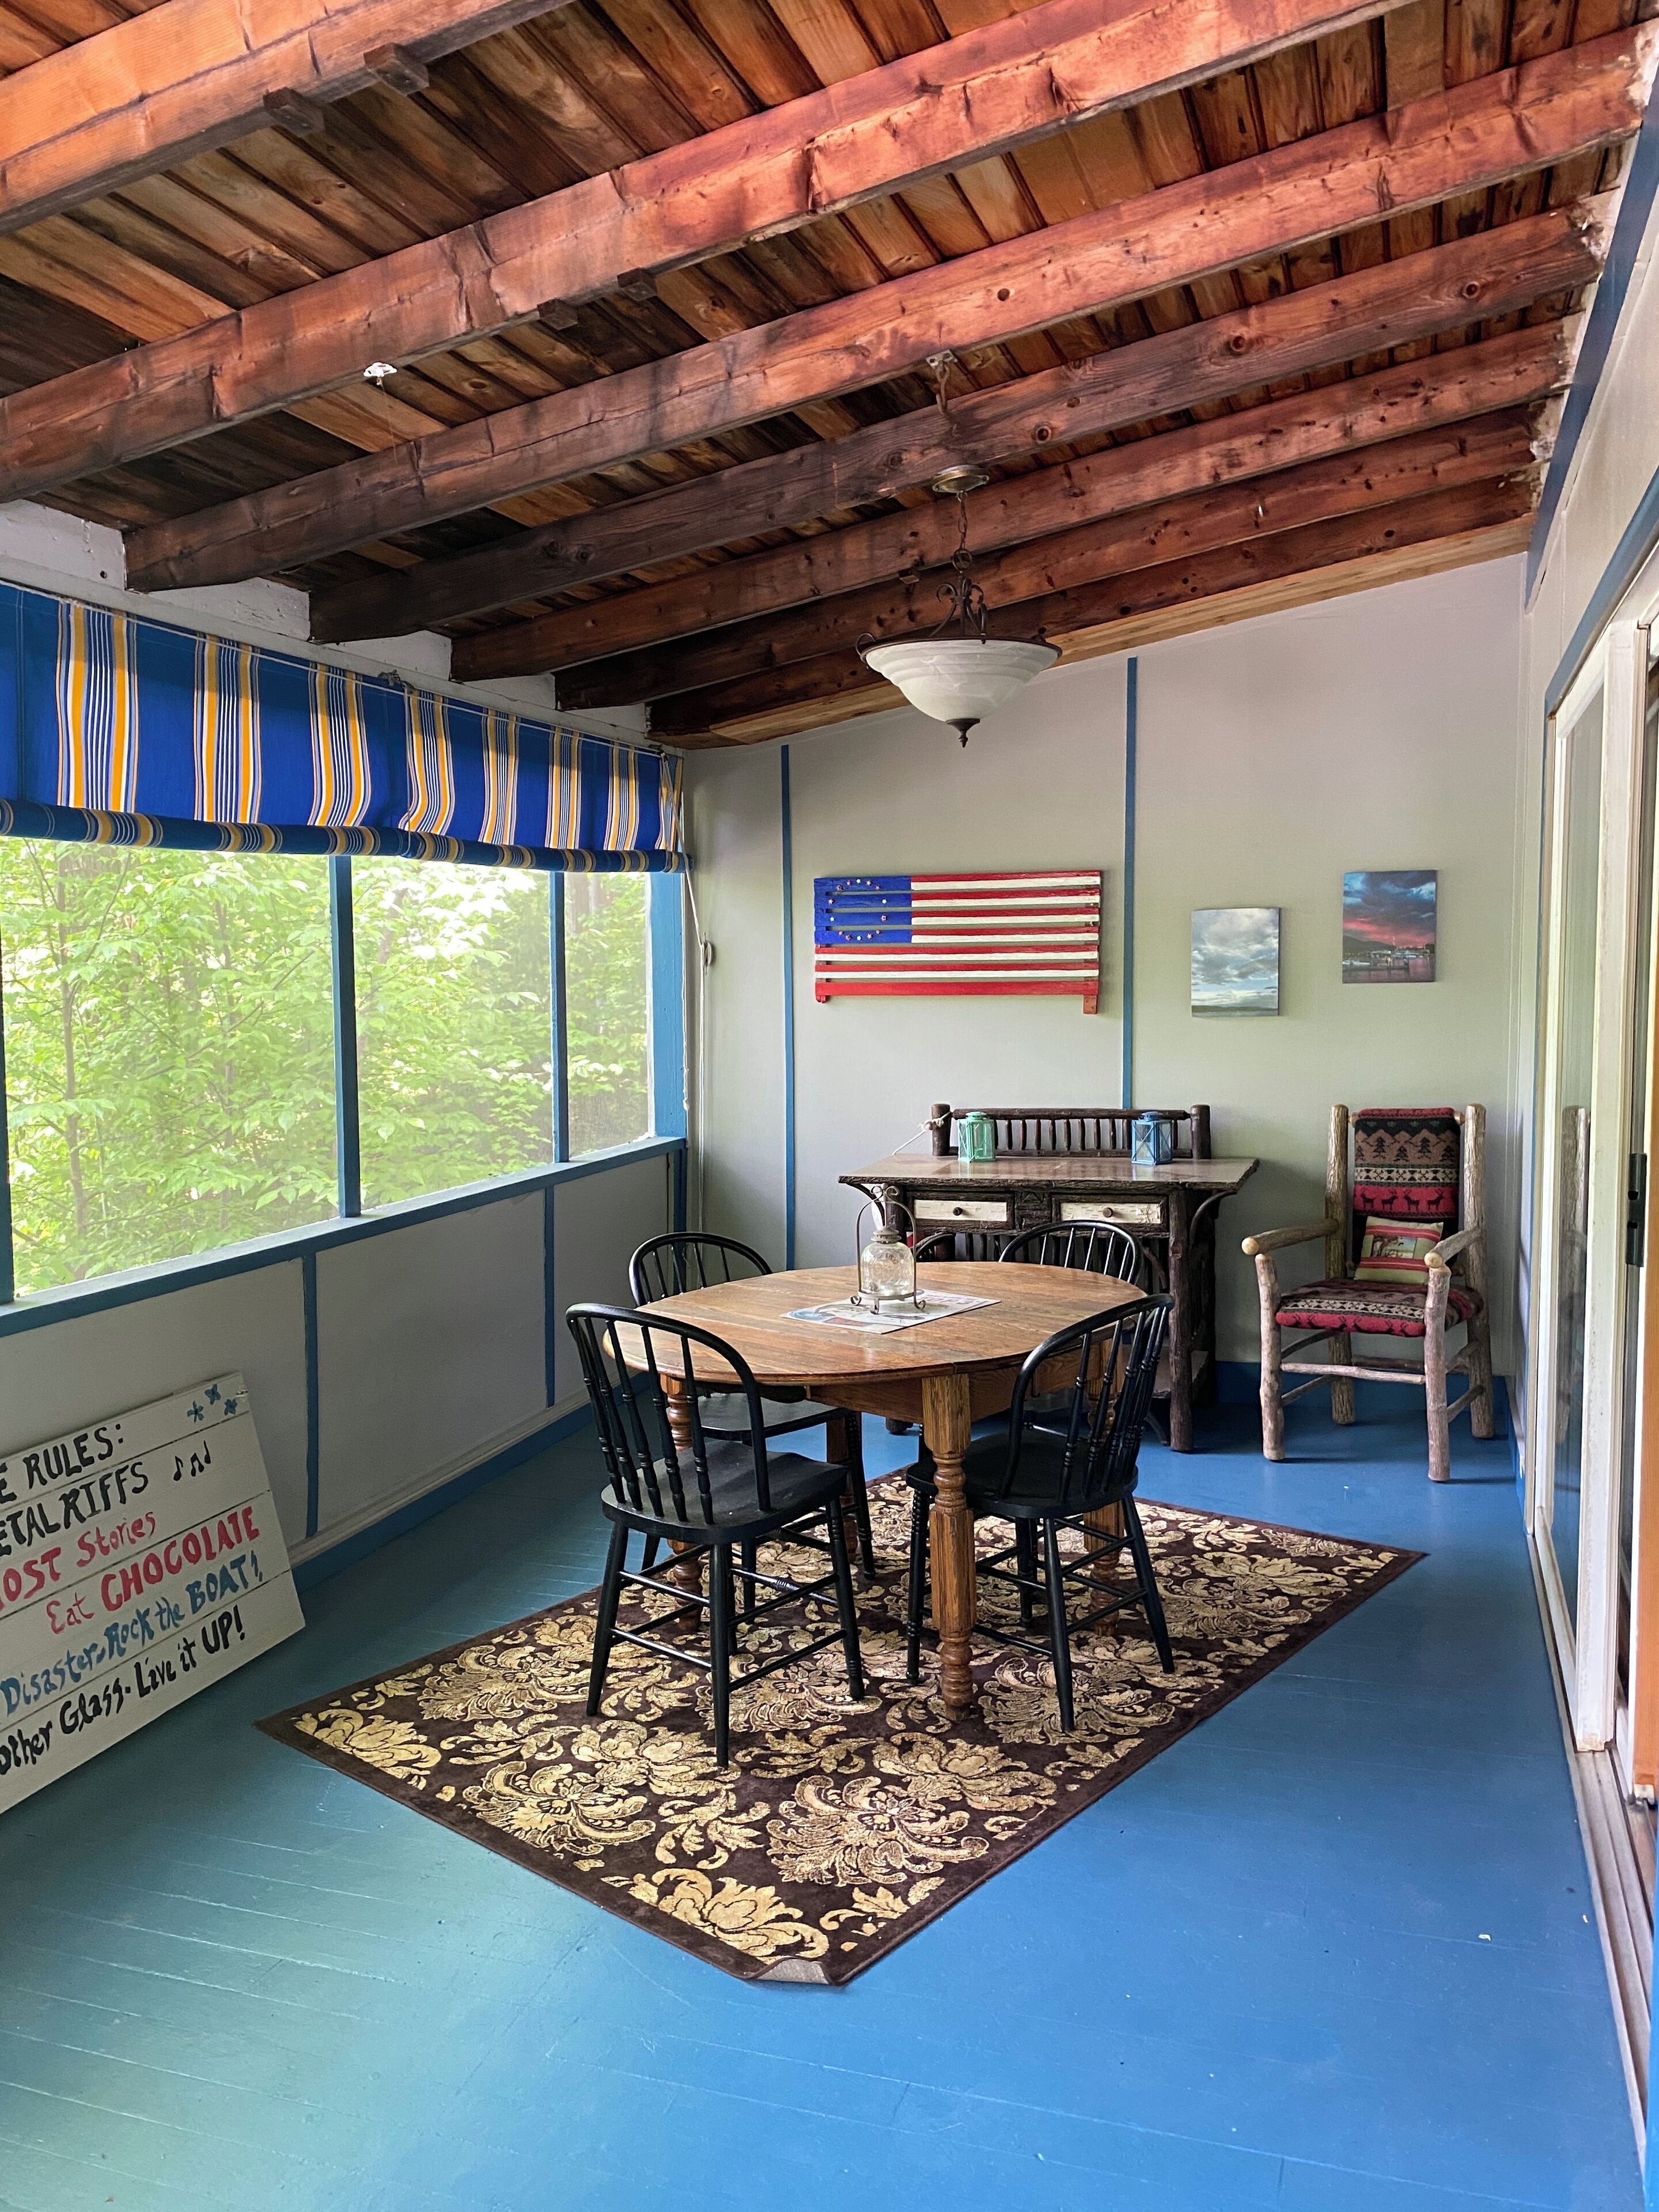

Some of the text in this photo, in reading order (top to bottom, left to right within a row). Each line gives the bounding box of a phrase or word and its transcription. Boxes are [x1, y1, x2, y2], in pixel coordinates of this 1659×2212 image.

[22, 1423, 124, 1489] RULES:
[58, 1461, 149, 1529] RIFFS
[46, 1506, 260, 1634] Eat CHOCOLATE
[76, 1511, 156, 1567] Stories
[154, 1596, 185, 1631] the
[185, 1550, 263, 1614] BOAT!
[134, 1657, 177, 1698] Live
[177, 1637, 196, 1672] it
[201, 1604, 245, 1654] UP!
